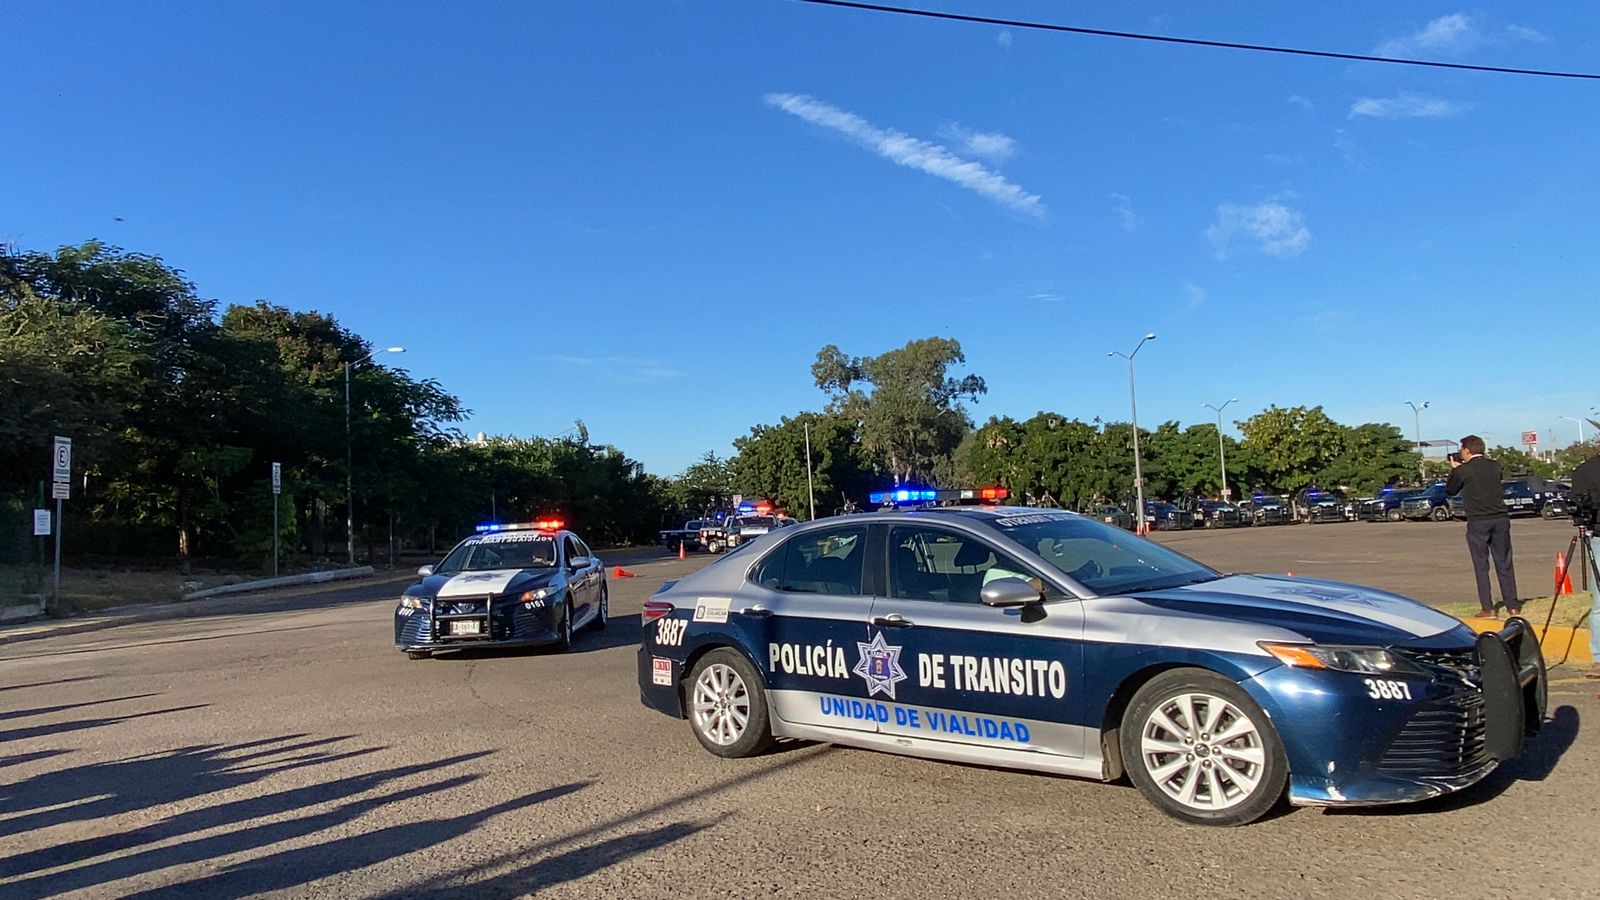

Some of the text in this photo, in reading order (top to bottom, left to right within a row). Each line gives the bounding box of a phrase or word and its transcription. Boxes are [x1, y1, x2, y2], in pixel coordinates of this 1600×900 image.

[59, 450, 65, 463] E
[525, 599, 545, 610] 0161
[656, 618, 688, 646] 3887
[769, 640, 1066, 699] POLICÍA DE TRANSITO
[1365, 679, 1412, 699] 3887
[820, 697, 1030, 743] UNIDAD DE VIALIDAD
